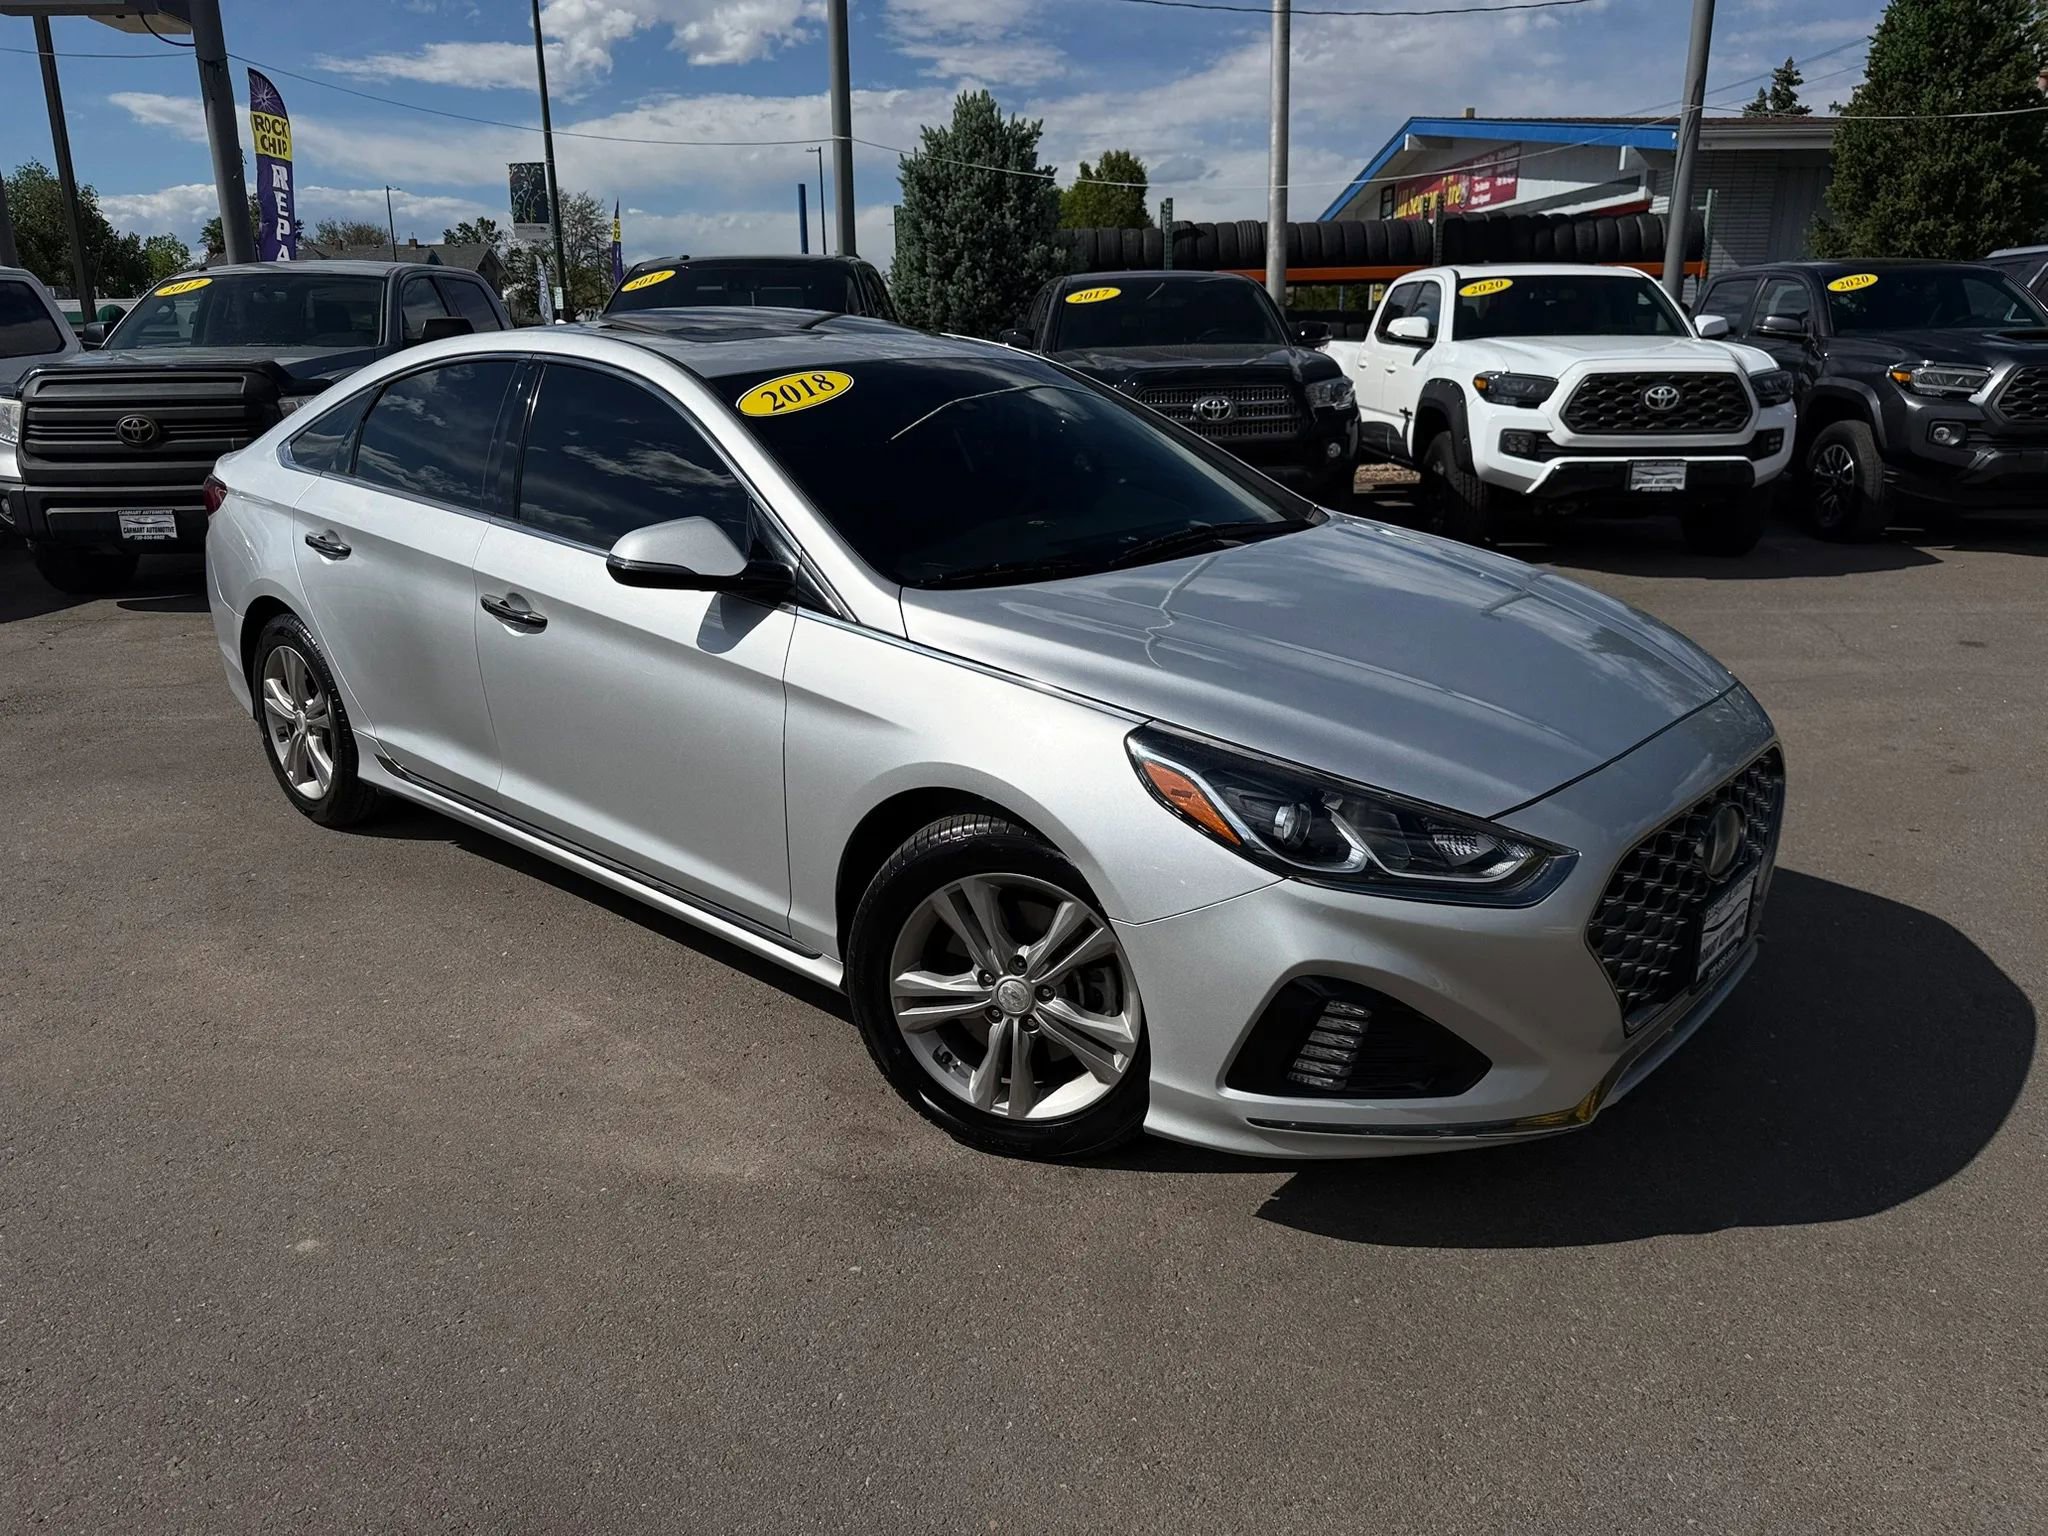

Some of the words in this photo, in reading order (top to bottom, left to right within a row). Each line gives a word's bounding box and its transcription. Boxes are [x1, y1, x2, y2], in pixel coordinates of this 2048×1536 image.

[253, 114, 289, 139] ROCK
[260, 134, 289, 156] CHIP
[163, 280, 204, 294] 2017
[630, 272, 666, 289] 2017
[1471, 280, 1503, 294] 2020
[1839, 275, 1869, 289] 2020
[1074, 289, 1110, 302] 2017
[760, 374, 835, 411] 2018
